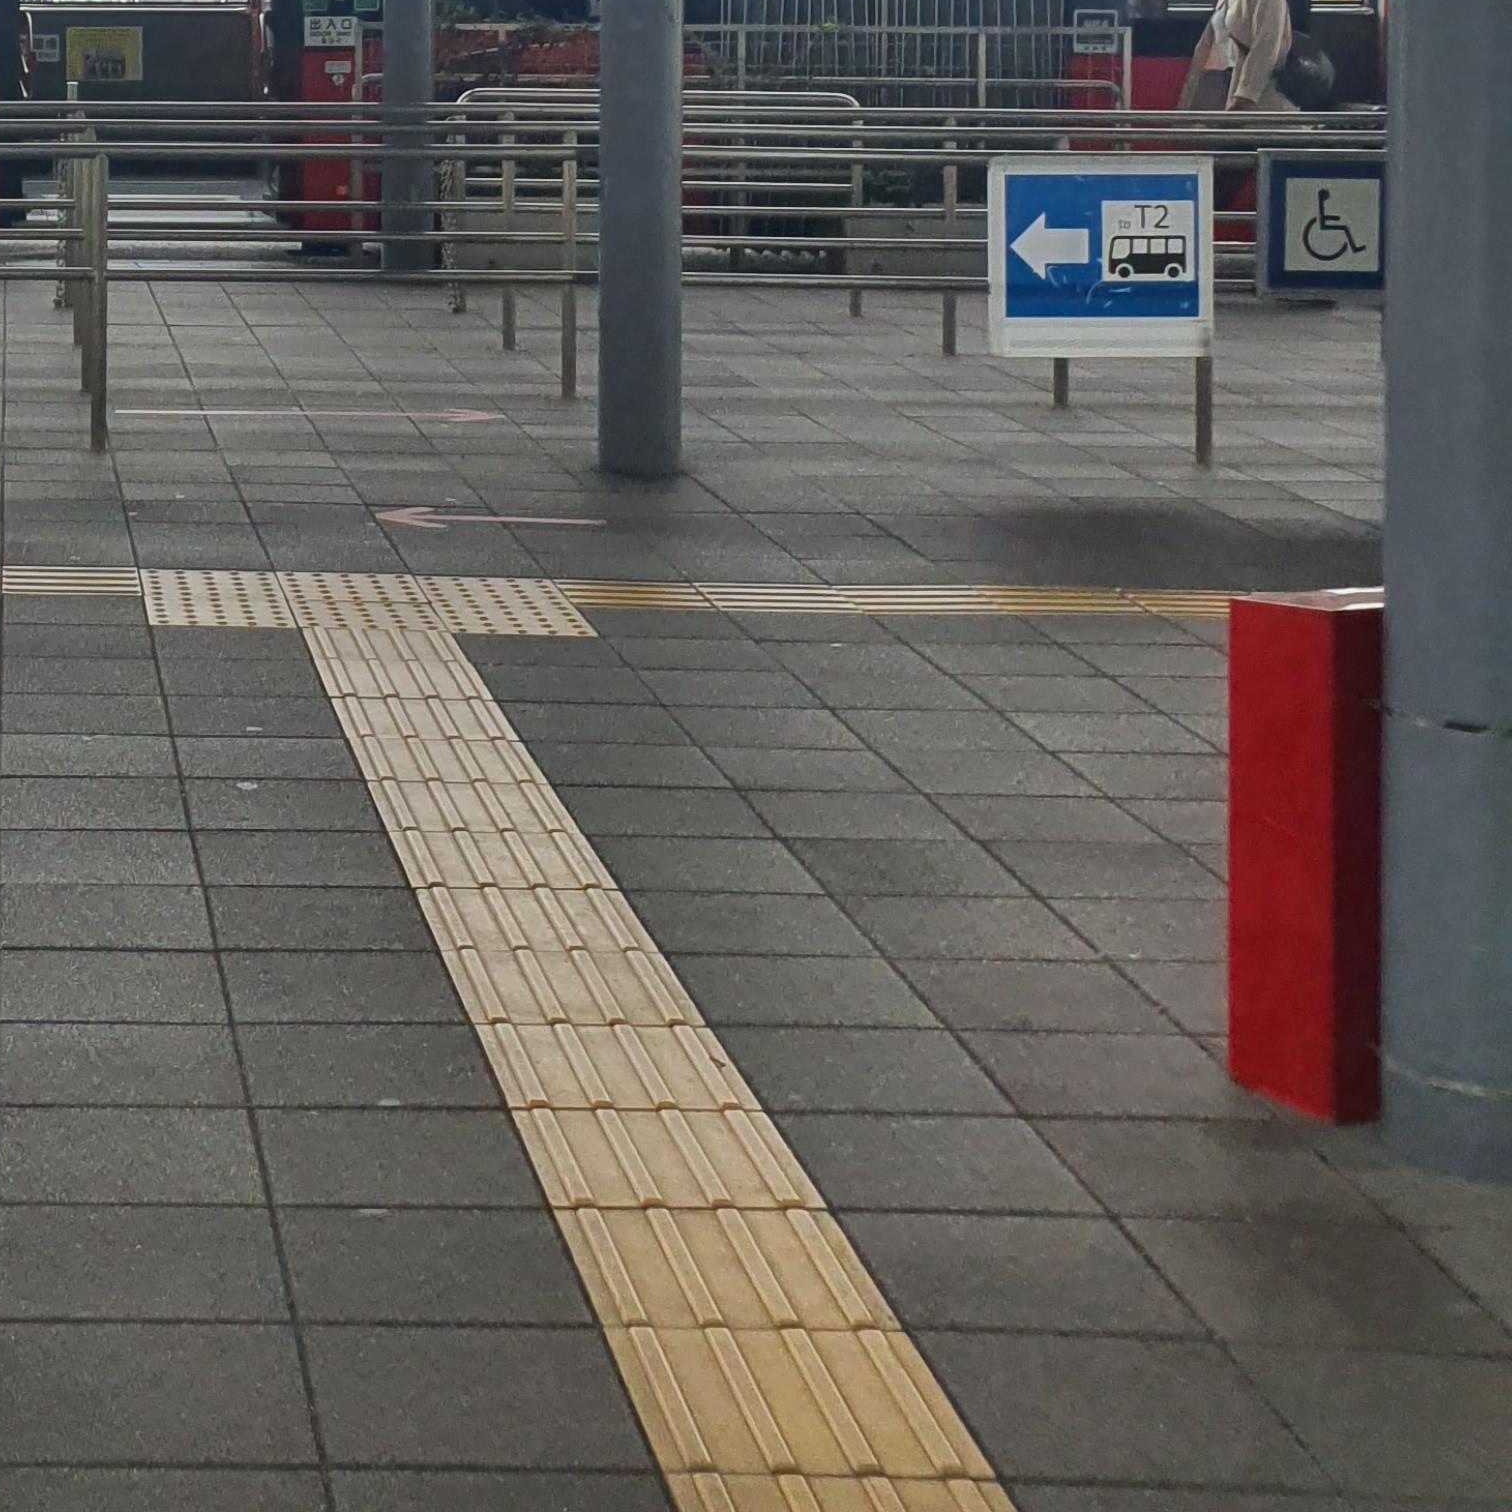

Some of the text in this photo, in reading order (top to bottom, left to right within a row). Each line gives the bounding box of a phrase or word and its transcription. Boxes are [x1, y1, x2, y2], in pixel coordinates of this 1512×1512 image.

[310, 18, 353, 30] 出入口
[1119, 204, 1170, 229] to T2
